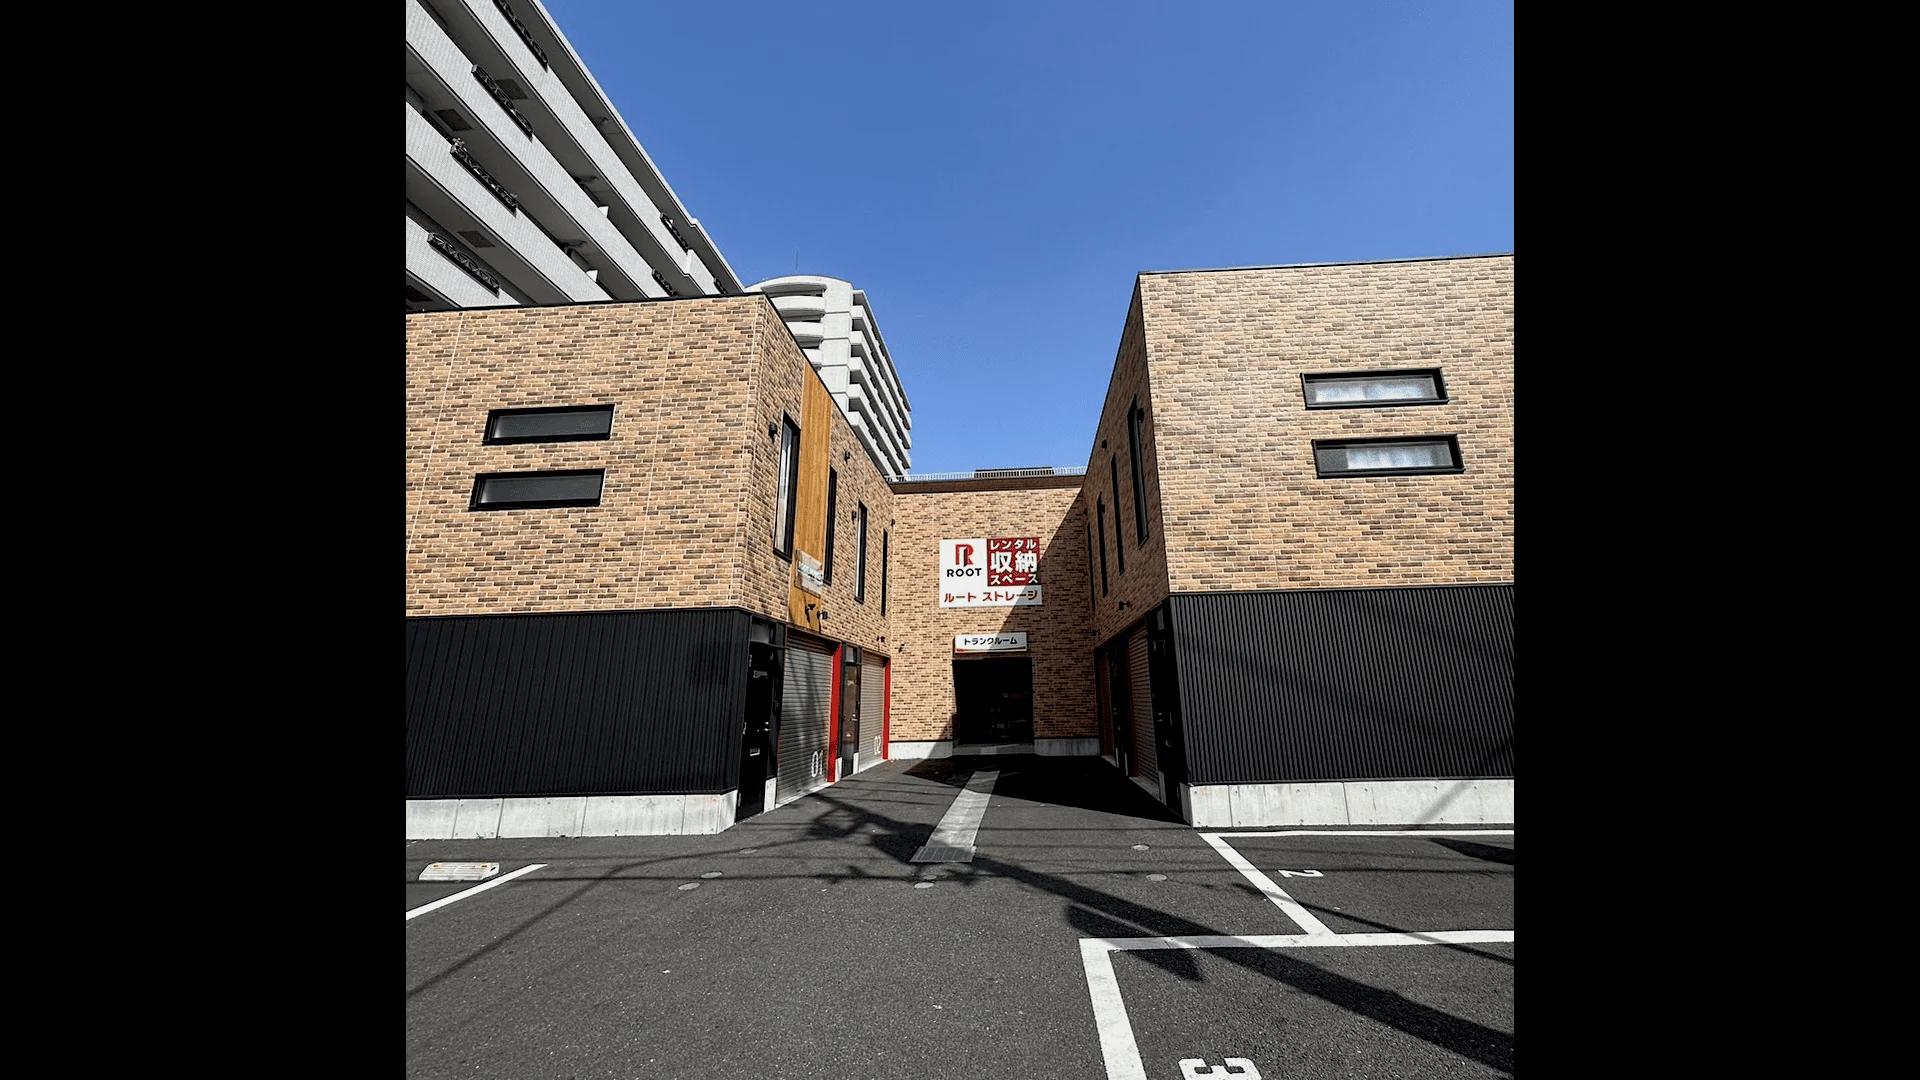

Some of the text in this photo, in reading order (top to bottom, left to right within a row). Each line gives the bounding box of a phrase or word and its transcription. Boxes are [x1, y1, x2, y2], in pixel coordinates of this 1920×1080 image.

[990, 539, 1037, 550] レンタル
[990, 550, 1038, 573] 収納
[946, 568, 982, 577] ROOT
[990, 573, 1038, 585] スペース
[944, 590, 1038, 603] ルート ストレージ
[964, 637, 1018, 645] トランクルーム
[811, 750, 823, 777] 01
[1278, 869, 1324, 878] 2
